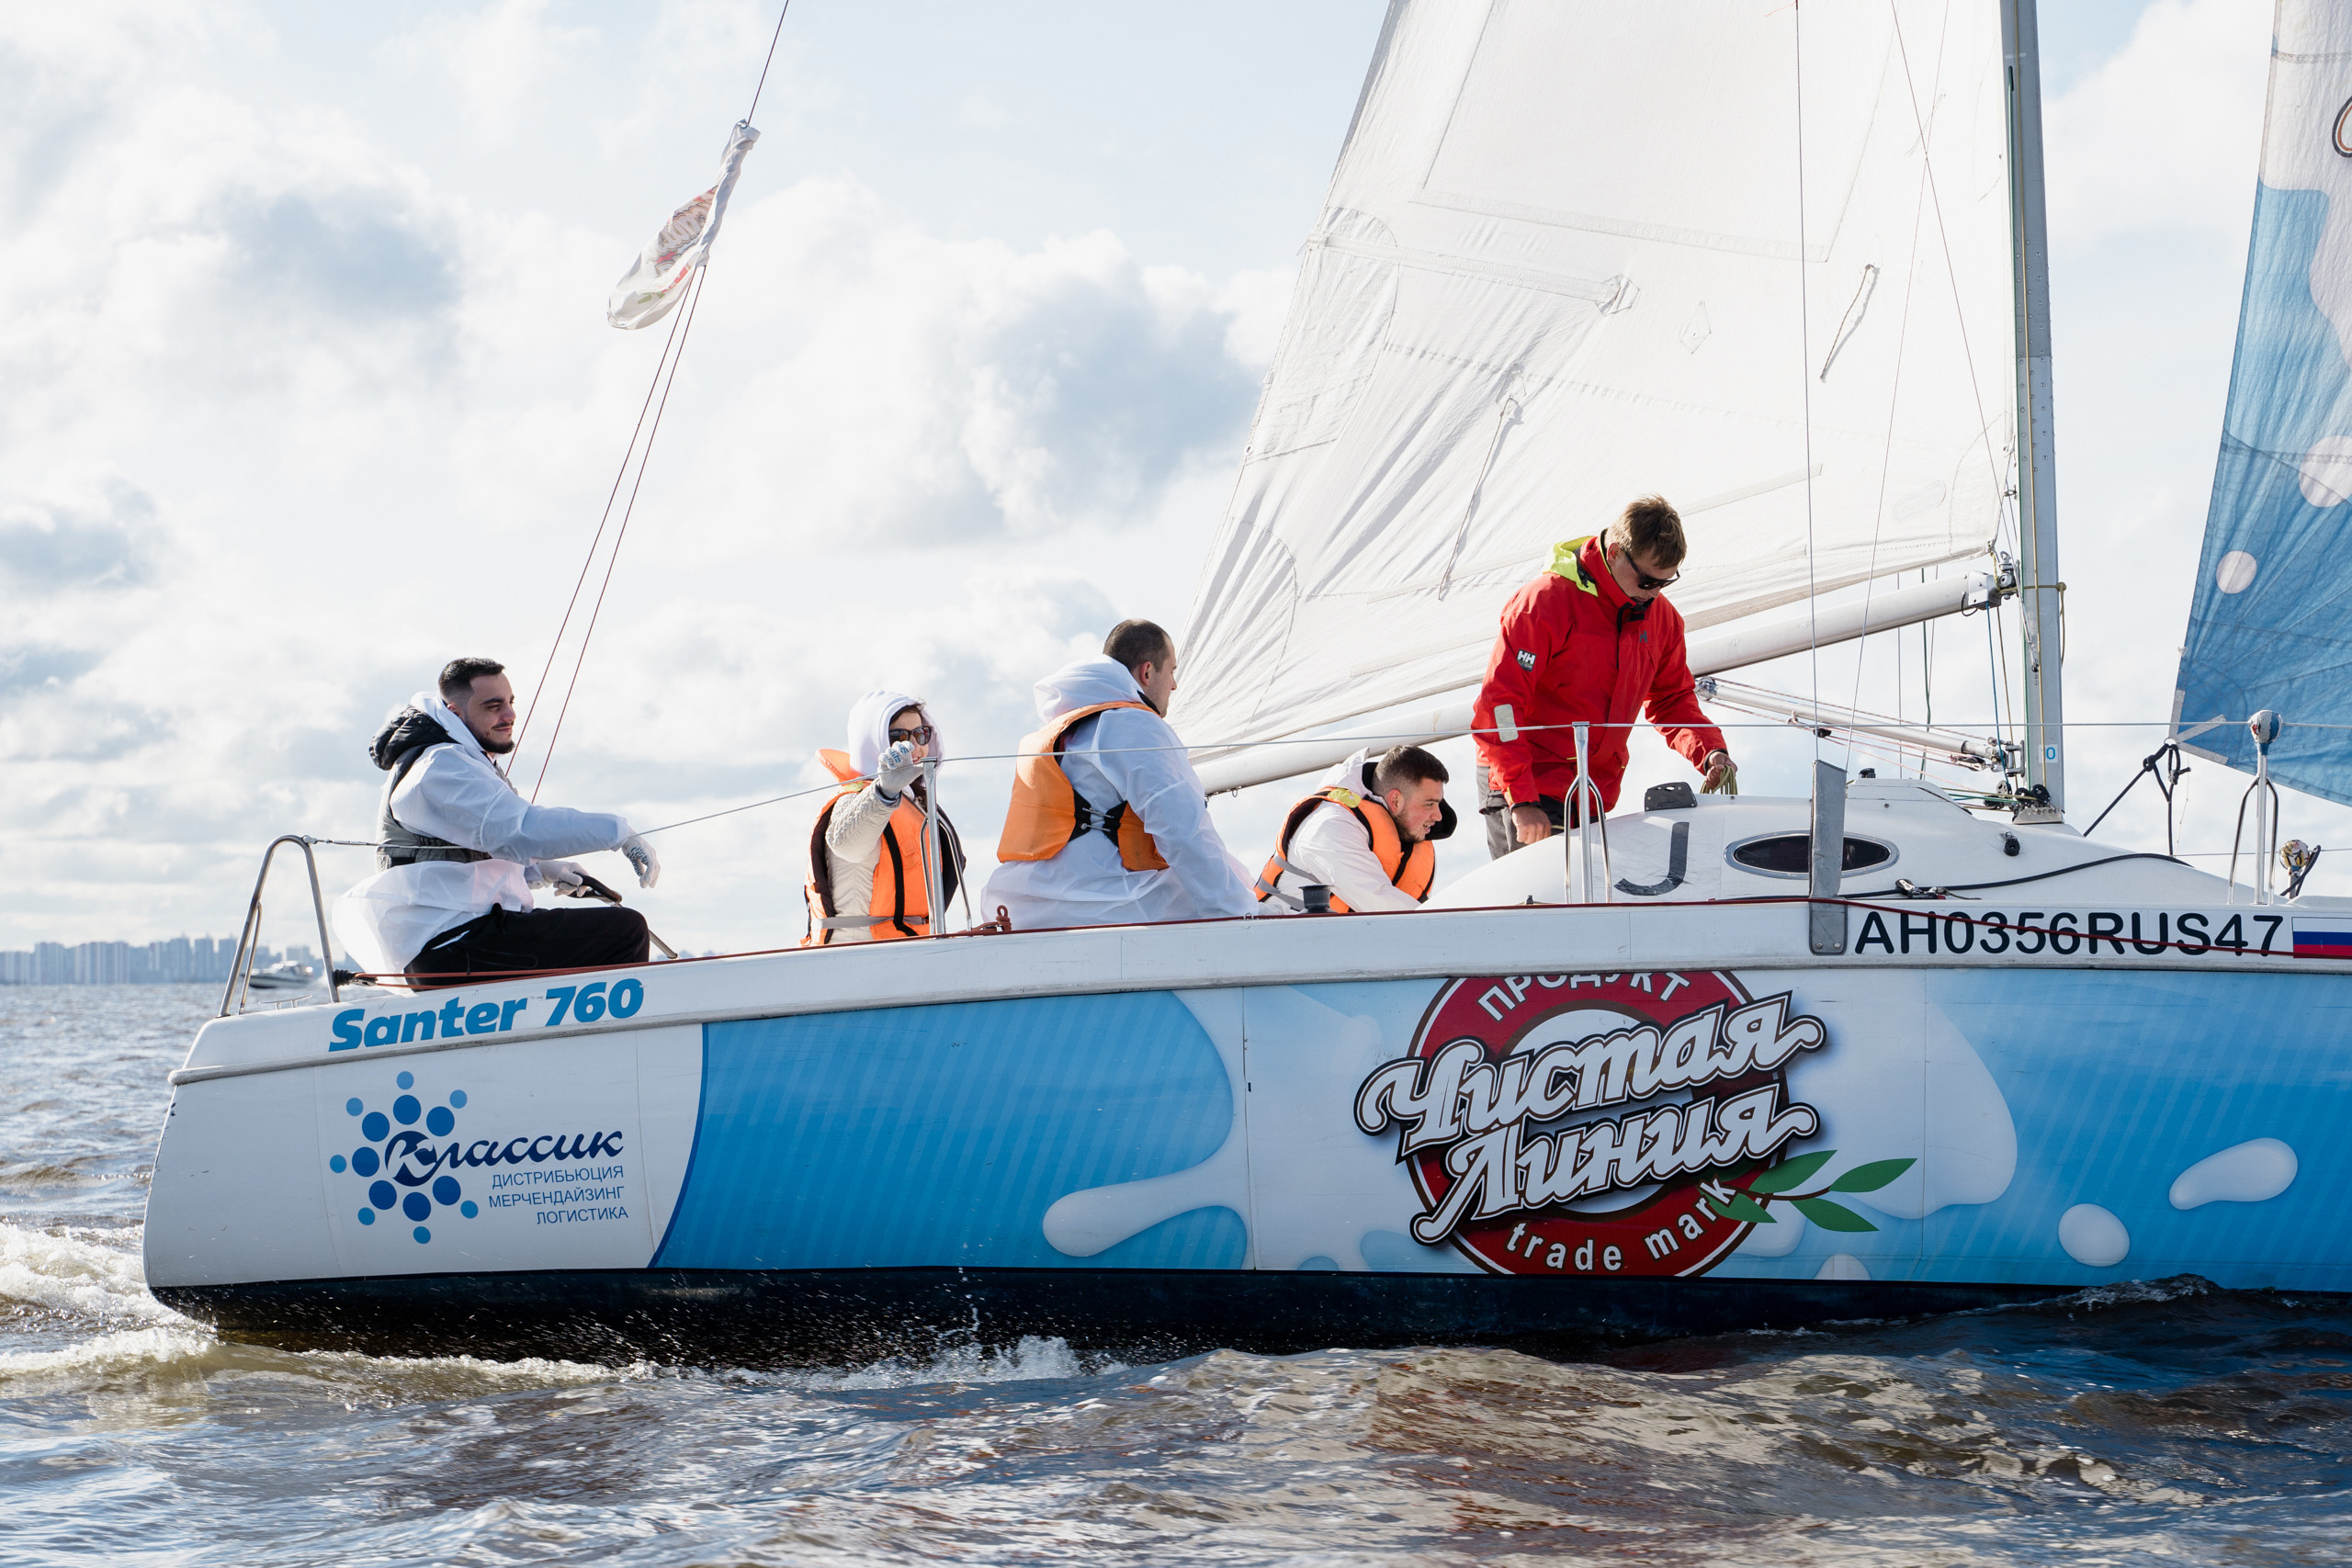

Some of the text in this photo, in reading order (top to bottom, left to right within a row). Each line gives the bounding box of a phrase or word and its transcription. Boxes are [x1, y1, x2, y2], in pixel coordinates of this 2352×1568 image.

[1854, 911, 2284, 956] AH0356RUS47
[328, 978, 644, 1053] Santer 760
[1355, 991, 1826, 1162] Чистая
[384, 1130, 624, 1187] Классик
[492, 1166, 624, 1190] ДИСТРИБЬЮЦИЯ
[1411, 1085, 1819, 1245] Линия
[489, 1186, 625, 1208] МЕРЧЕНДАЙЗИНГ
[537, 1206, 629, 1225] ЛОГИСТИКА
[1507, 1178, 1736, 1271] trade mark
